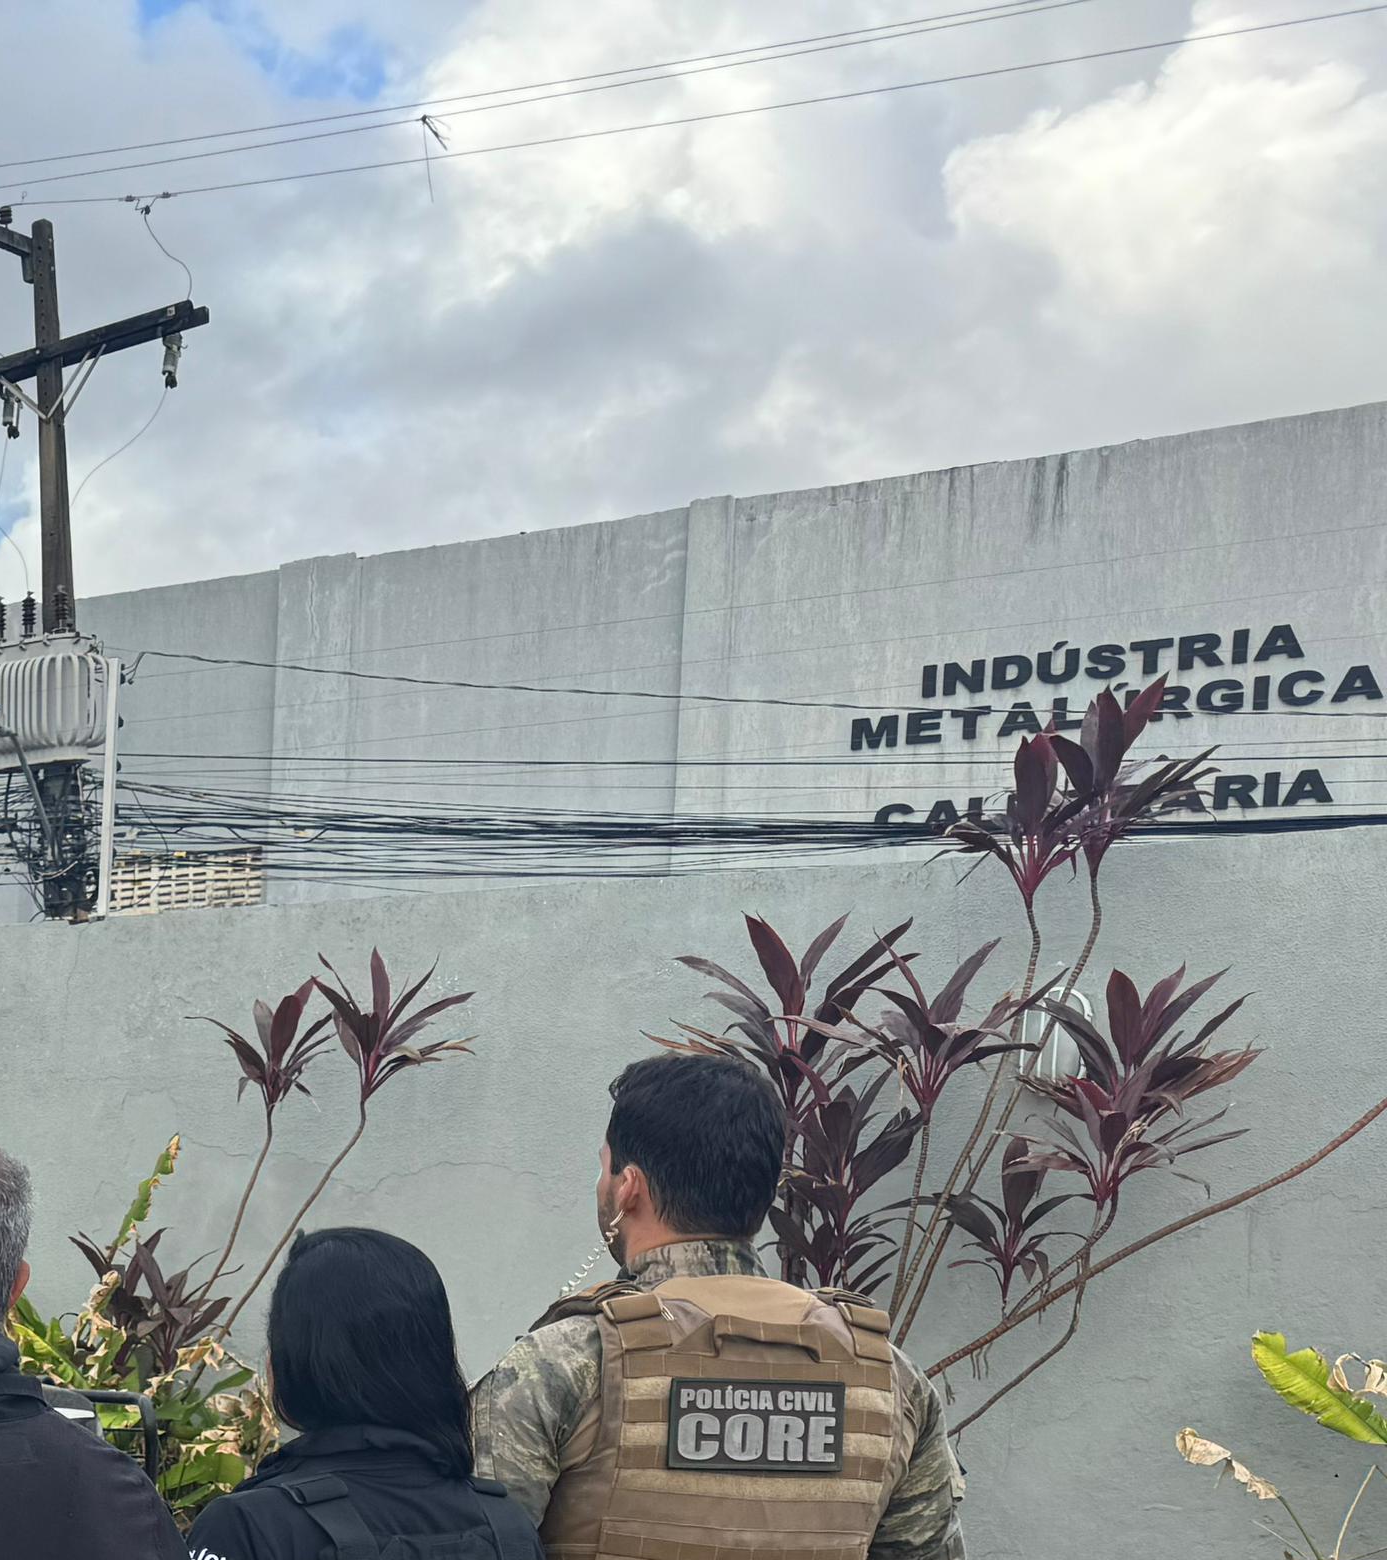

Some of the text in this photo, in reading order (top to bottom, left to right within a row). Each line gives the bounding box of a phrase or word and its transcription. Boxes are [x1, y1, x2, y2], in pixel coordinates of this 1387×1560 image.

[921, 623, 1305, 699] INDÚSTRIA
[679, 1385, 836, 1412] POLÍCIA CIVIL
[677, 1412, 836, 1462] CORE
